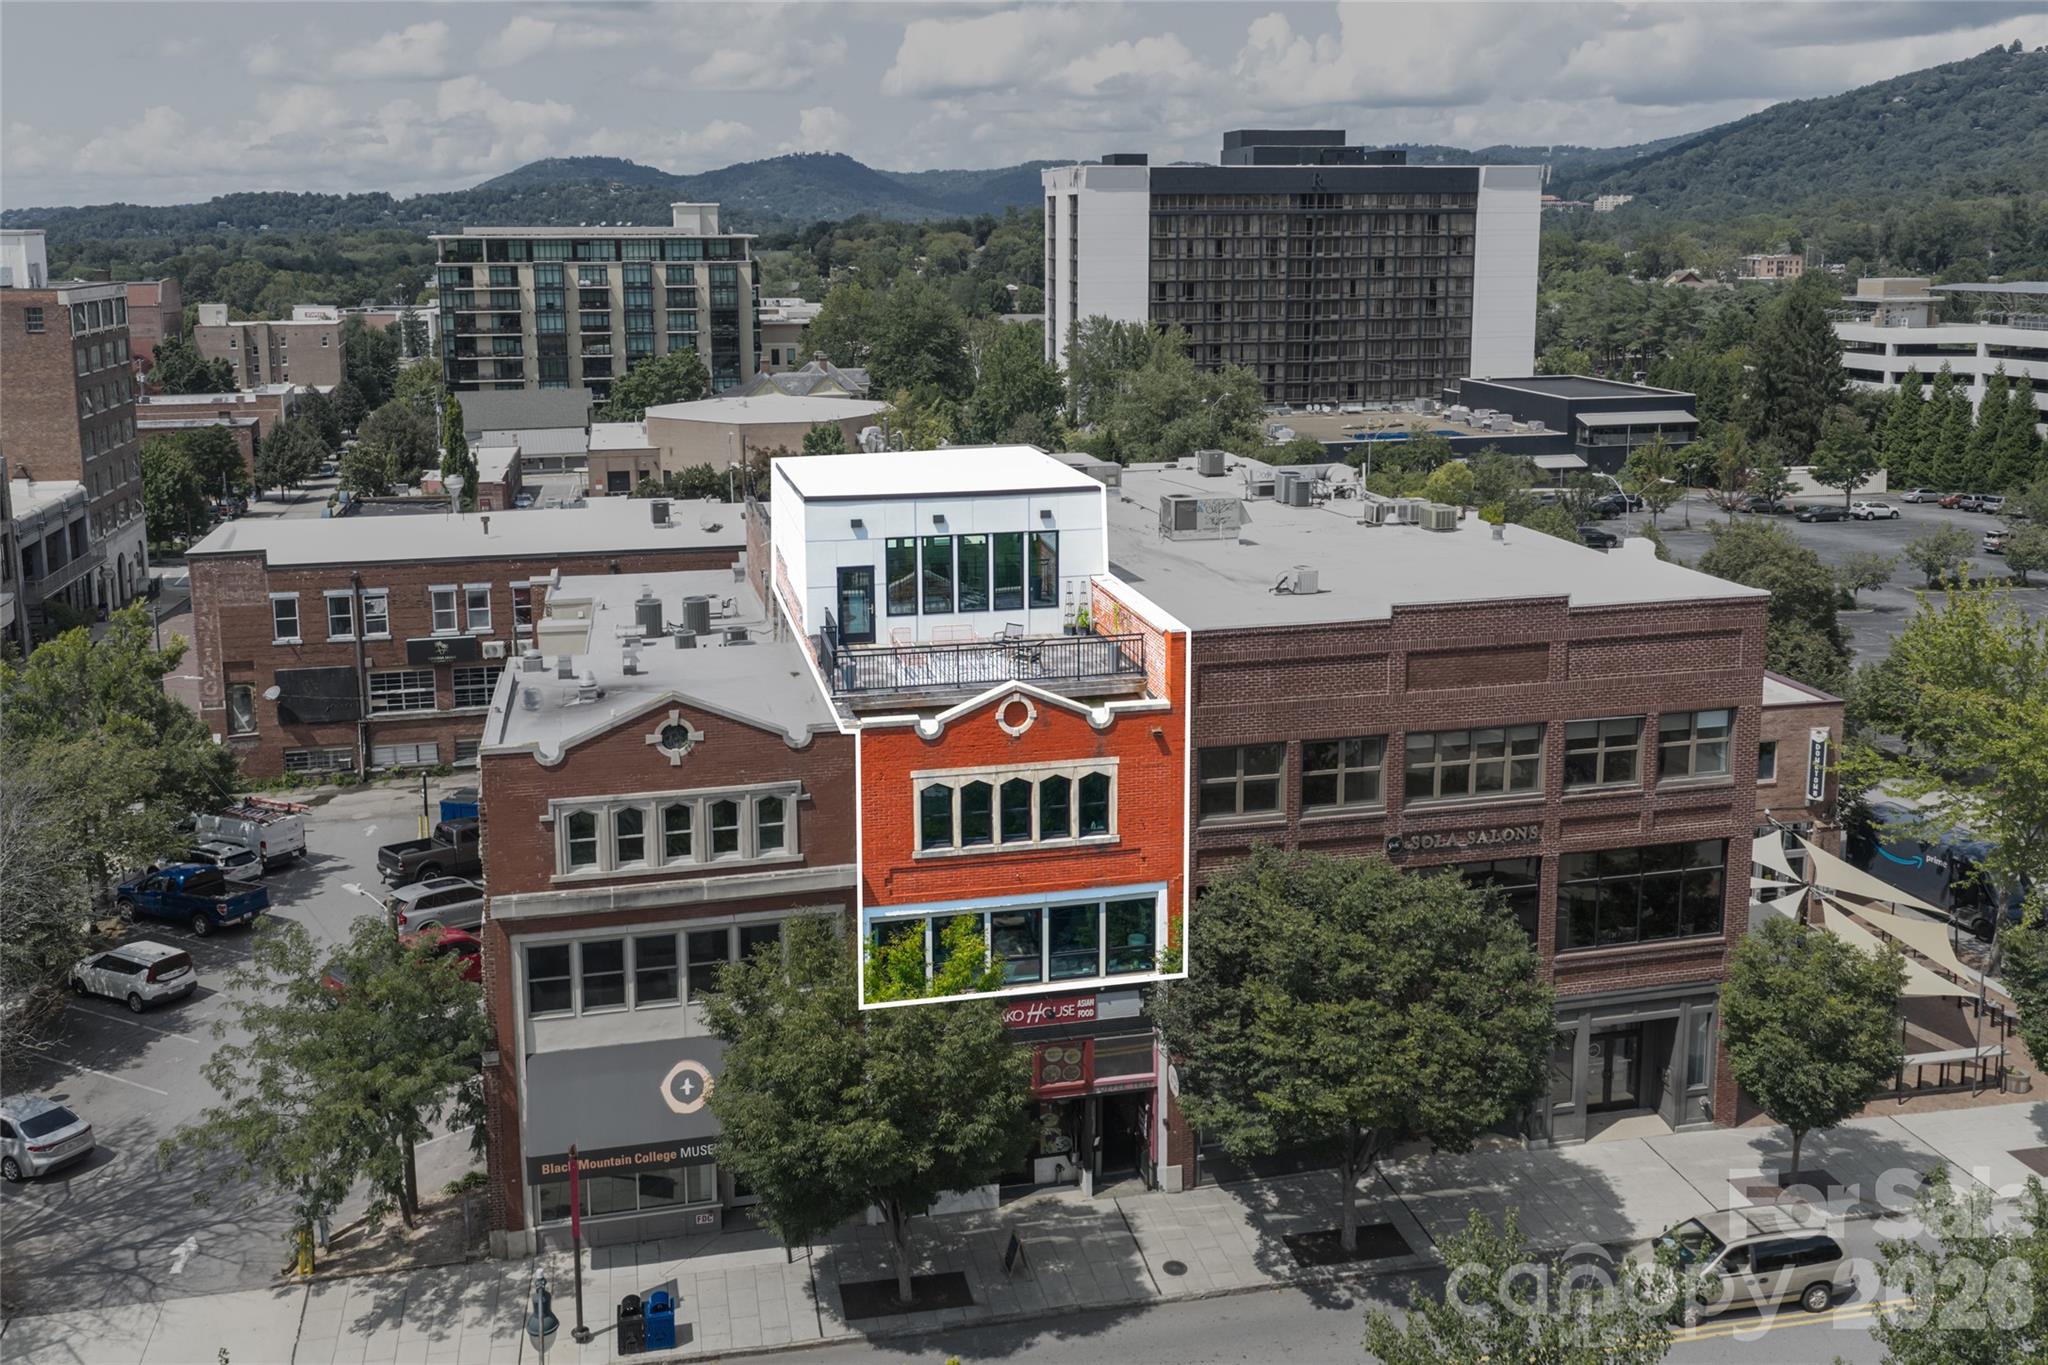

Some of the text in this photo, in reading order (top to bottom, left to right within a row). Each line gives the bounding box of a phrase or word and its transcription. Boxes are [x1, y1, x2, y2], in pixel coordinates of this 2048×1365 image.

[1410, 833, 1459, 850] SOLA
[1467, 825, 1539, 845] SALONS
[1925, 855, 1948, 867] prime
[1077, 999, 1095, 1008] ASIAN
[1077, 1008, 1095, 1018] FOOD
[578, 1157, 632, 1170] Mountain
[635, 1150, 677, 1164] College
[680, 1143, 715, 1159] MUSE
